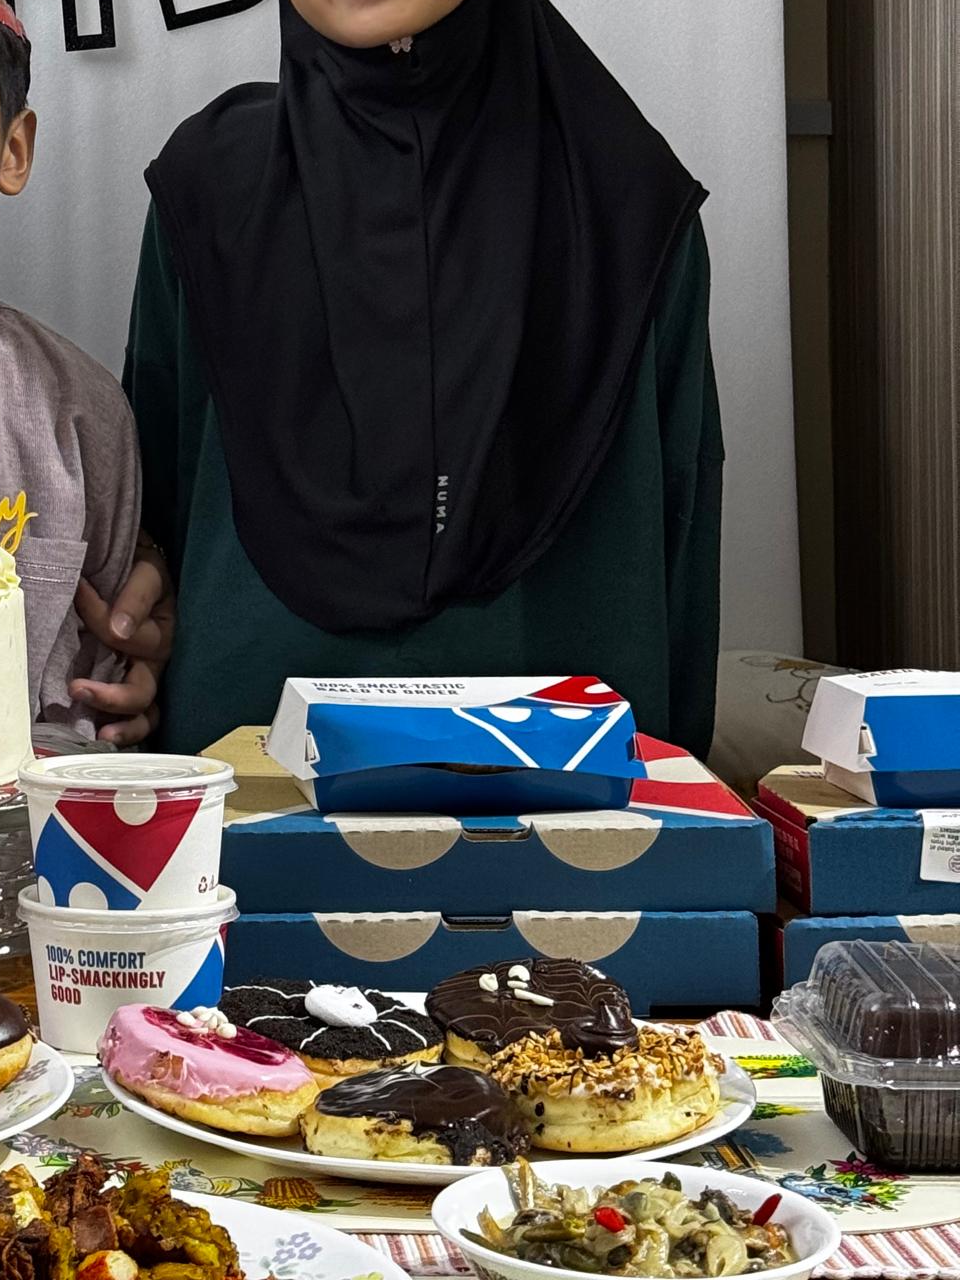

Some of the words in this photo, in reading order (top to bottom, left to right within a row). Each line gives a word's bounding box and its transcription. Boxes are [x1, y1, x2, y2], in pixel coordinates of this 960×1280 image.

[436, 475, 448, 534] NUMA
[46, 944, 74, 965] 100%
[78, 950, 146, 969] COMFORT
[49, 964, 166, 989] LIP-SMACKINGLY
[51, 984, 81, 1005] GOOD
